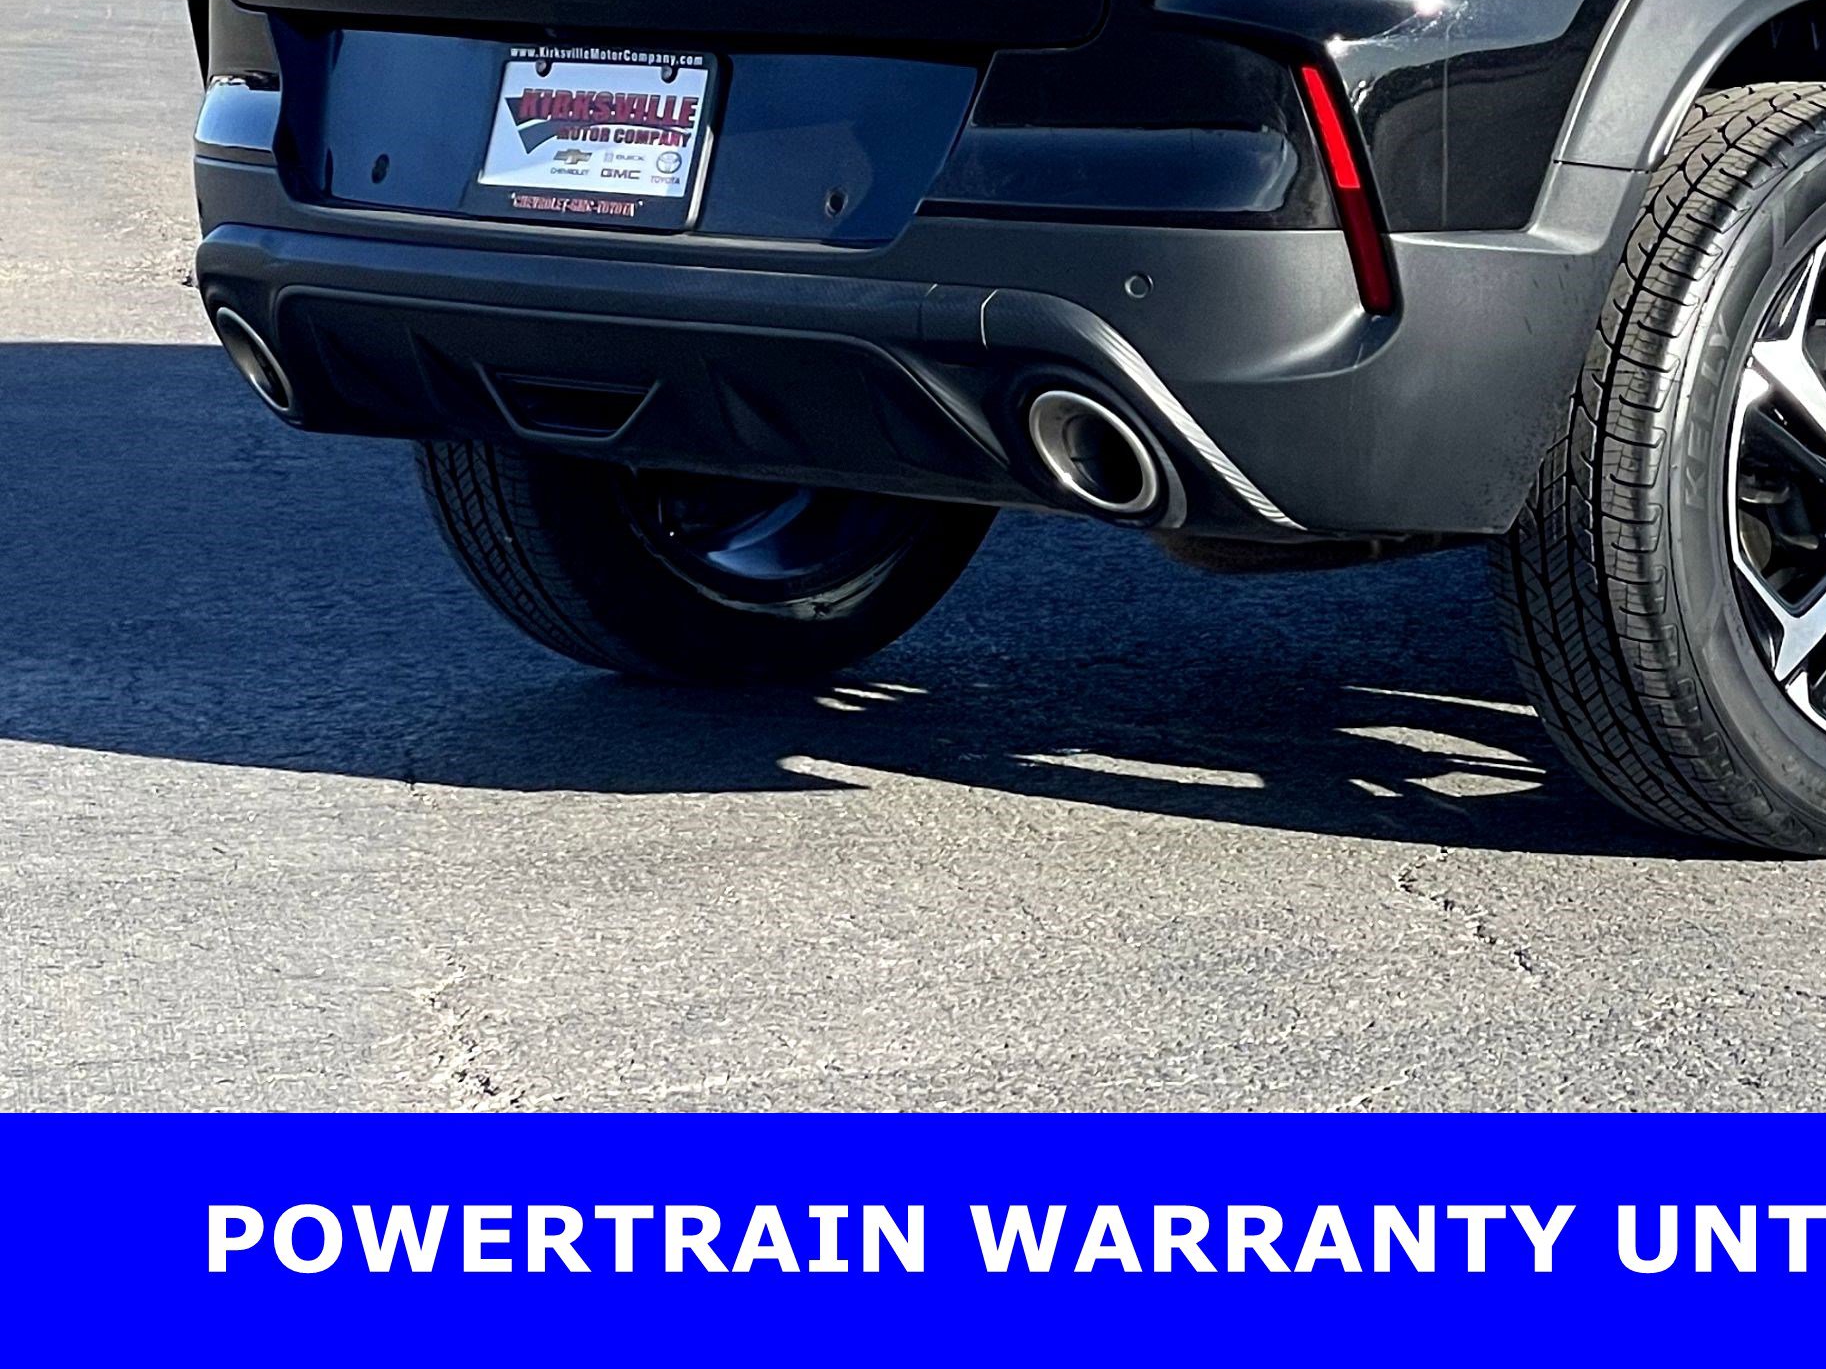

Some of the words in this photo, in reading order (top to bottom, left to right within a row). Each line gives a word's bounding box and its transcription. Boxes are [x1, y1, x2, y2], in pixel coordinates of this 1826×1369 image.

[510, 47, 704, 66] www.KirksvilleMotorCompany.com
[518, 88, 700, 129] KIRKSVILLE
[556, 126, 611, 143] MOTOR
[613, 128, 692, 148] COMPANY
[600, 168, 642, 180] GMC
[650, 175, 681, 185] TOYOTA
[1684, 313, 1731, 511] KELLY
